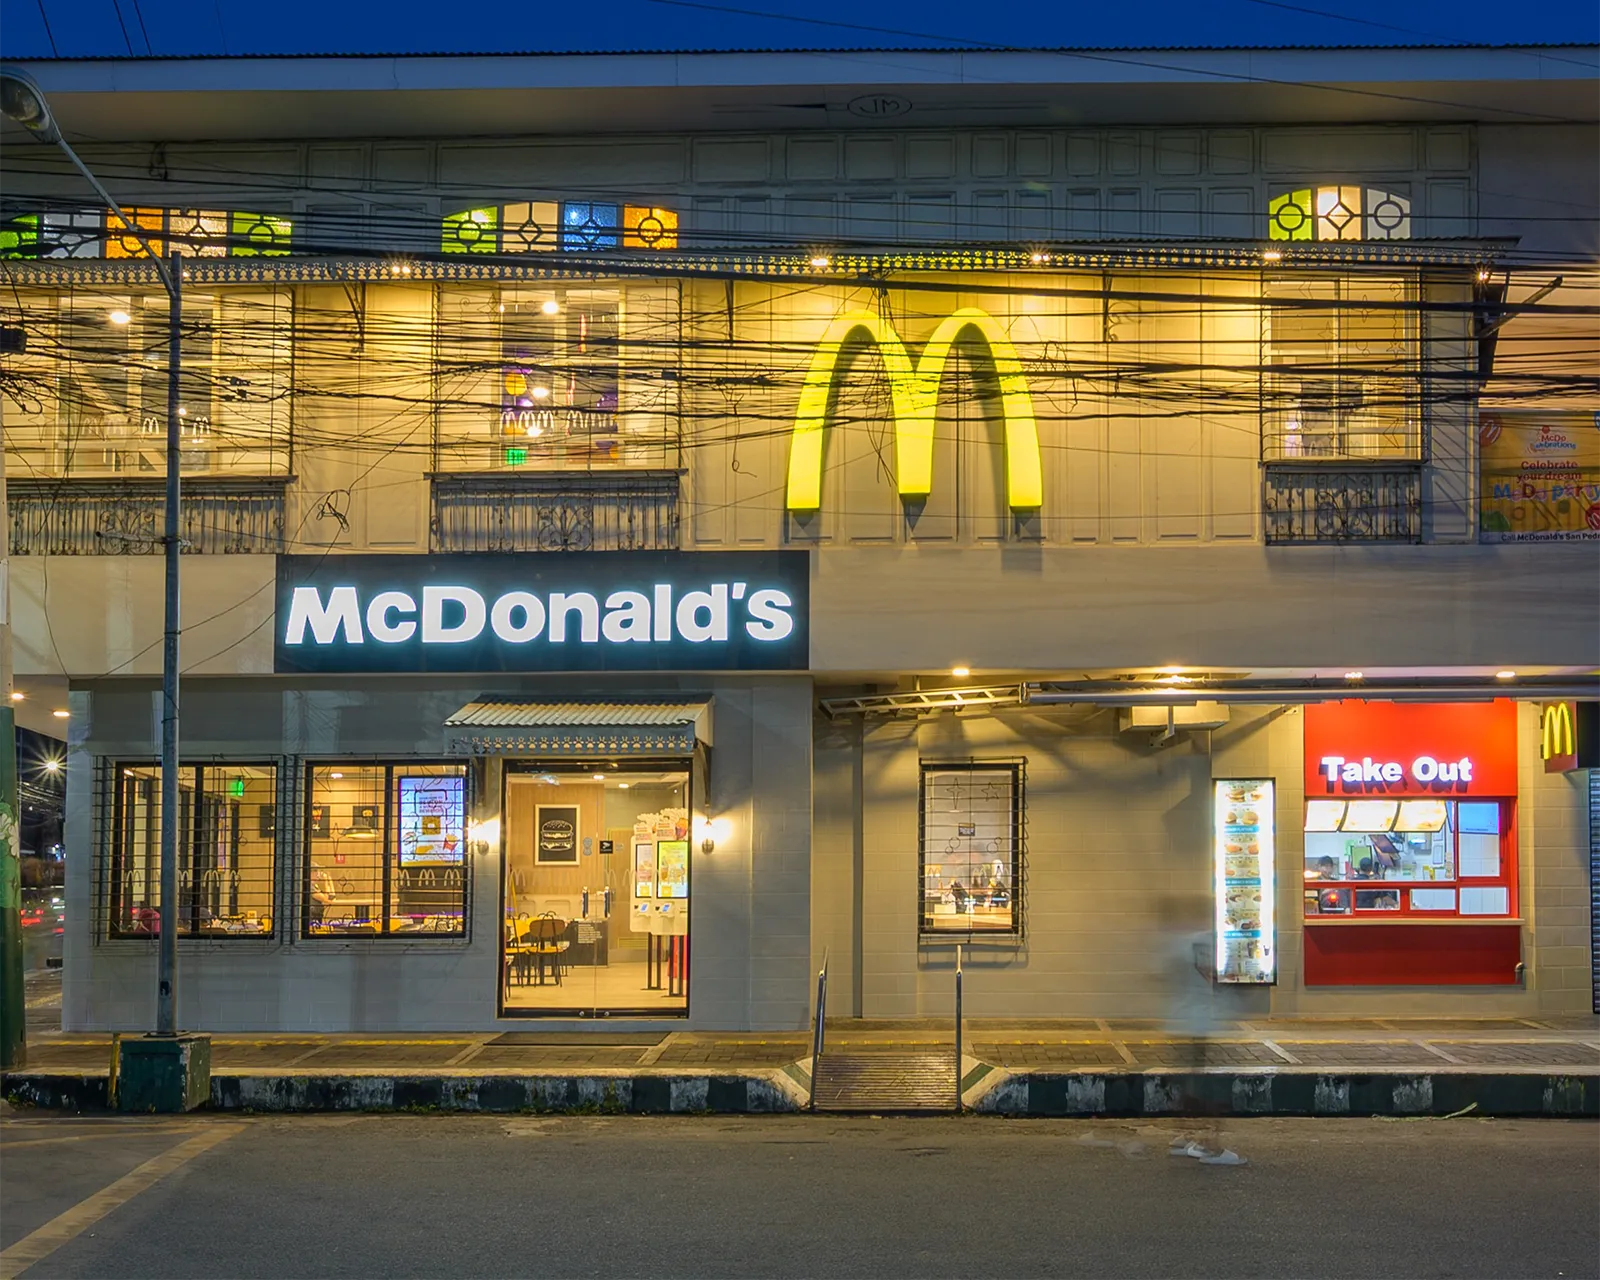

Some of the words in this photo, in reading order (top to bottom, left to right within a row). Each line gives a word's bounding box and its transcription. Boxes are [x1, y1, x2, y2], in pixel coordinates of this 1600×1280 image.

[1541, 434, 1567, 442] McDo
[1521, 460, 1578, 470] Celebrate
[1517, 473, 1543, 483] your
[1545, 471, 1582, 480] dream
[1493, 483, 1548, 501] McDo
[1552, 483, 1600, 502] party
[1517, 533, 1565, 541] McDonald's
[285, 582, 794, 645] McDonald's
[1321, 756, 1403, 782] Take
[1411, 756, 1473, 782] Out
